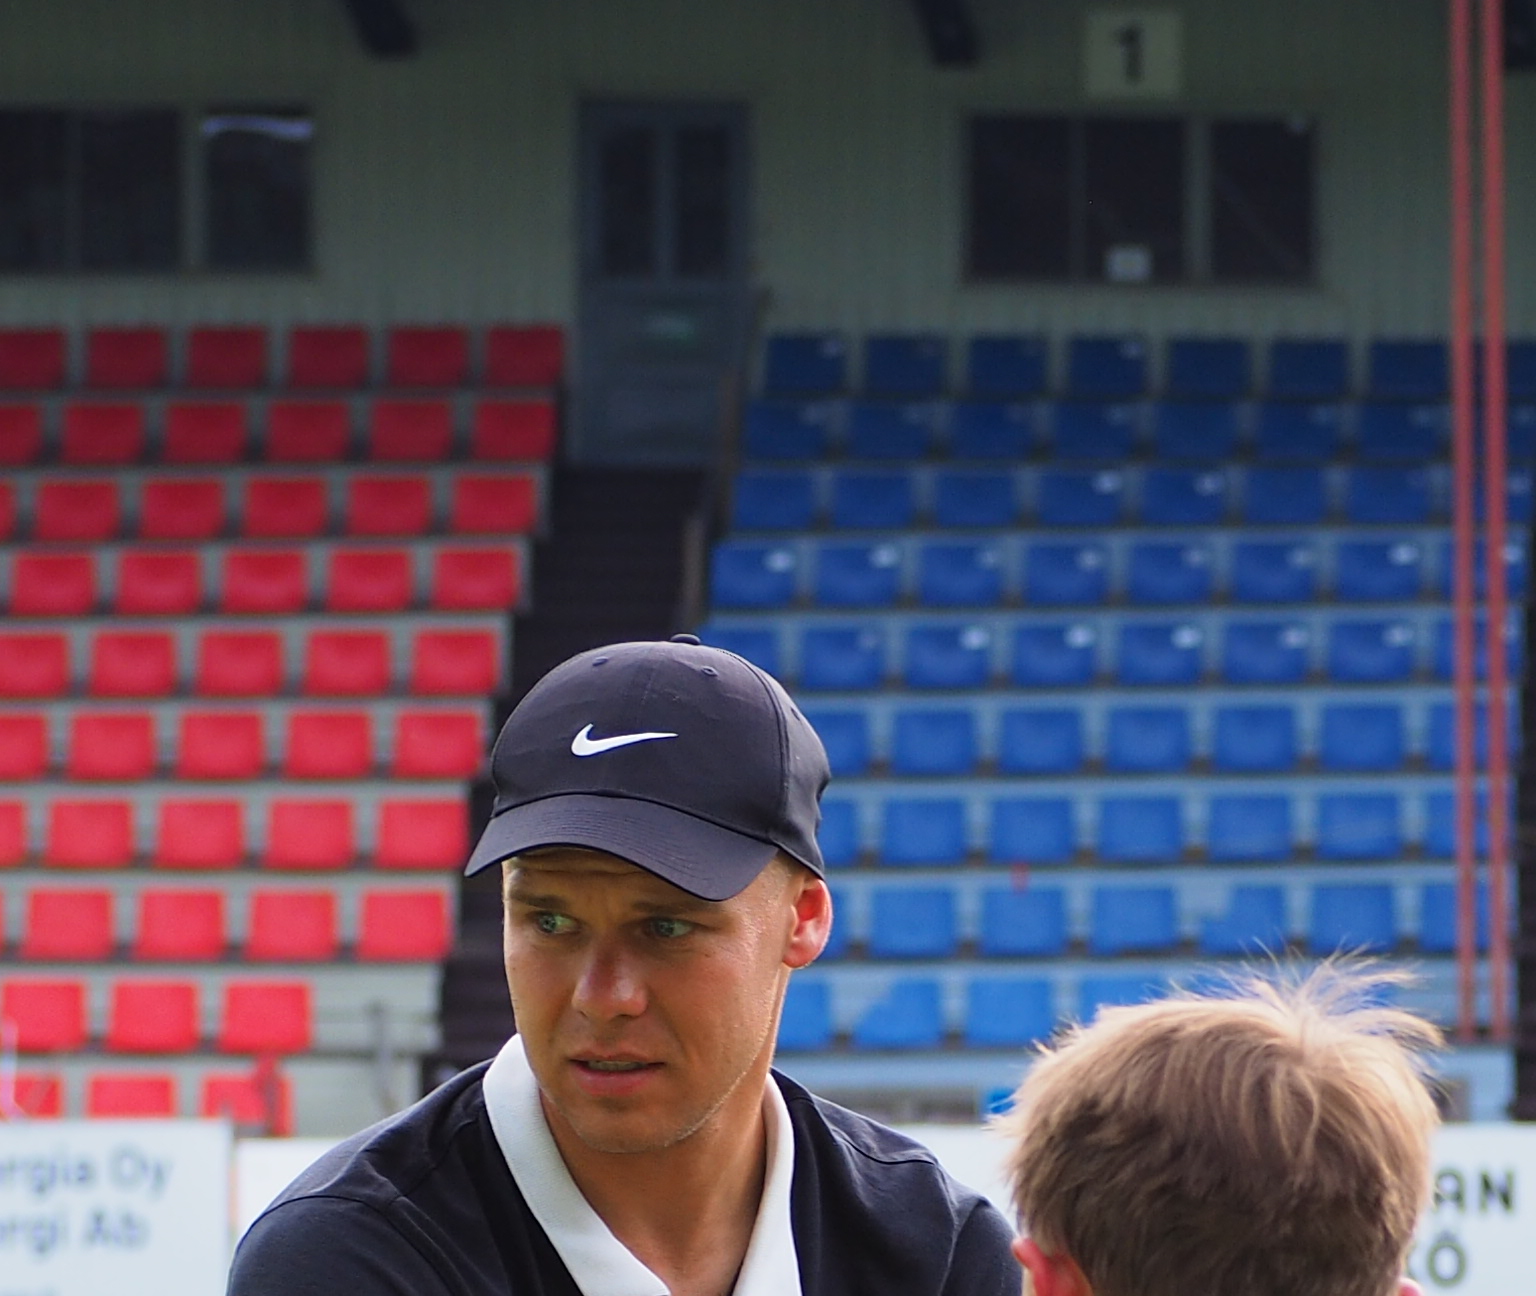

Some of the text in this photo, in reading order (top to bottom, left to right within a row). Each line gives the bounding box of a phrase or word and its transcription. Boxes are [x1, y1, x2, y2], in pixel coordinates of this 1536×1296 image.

[1113, 25, 1145, 82] 1
[109, 1145, 173, 1200] Oy
[84, 1207, 150, 1250] Ab
